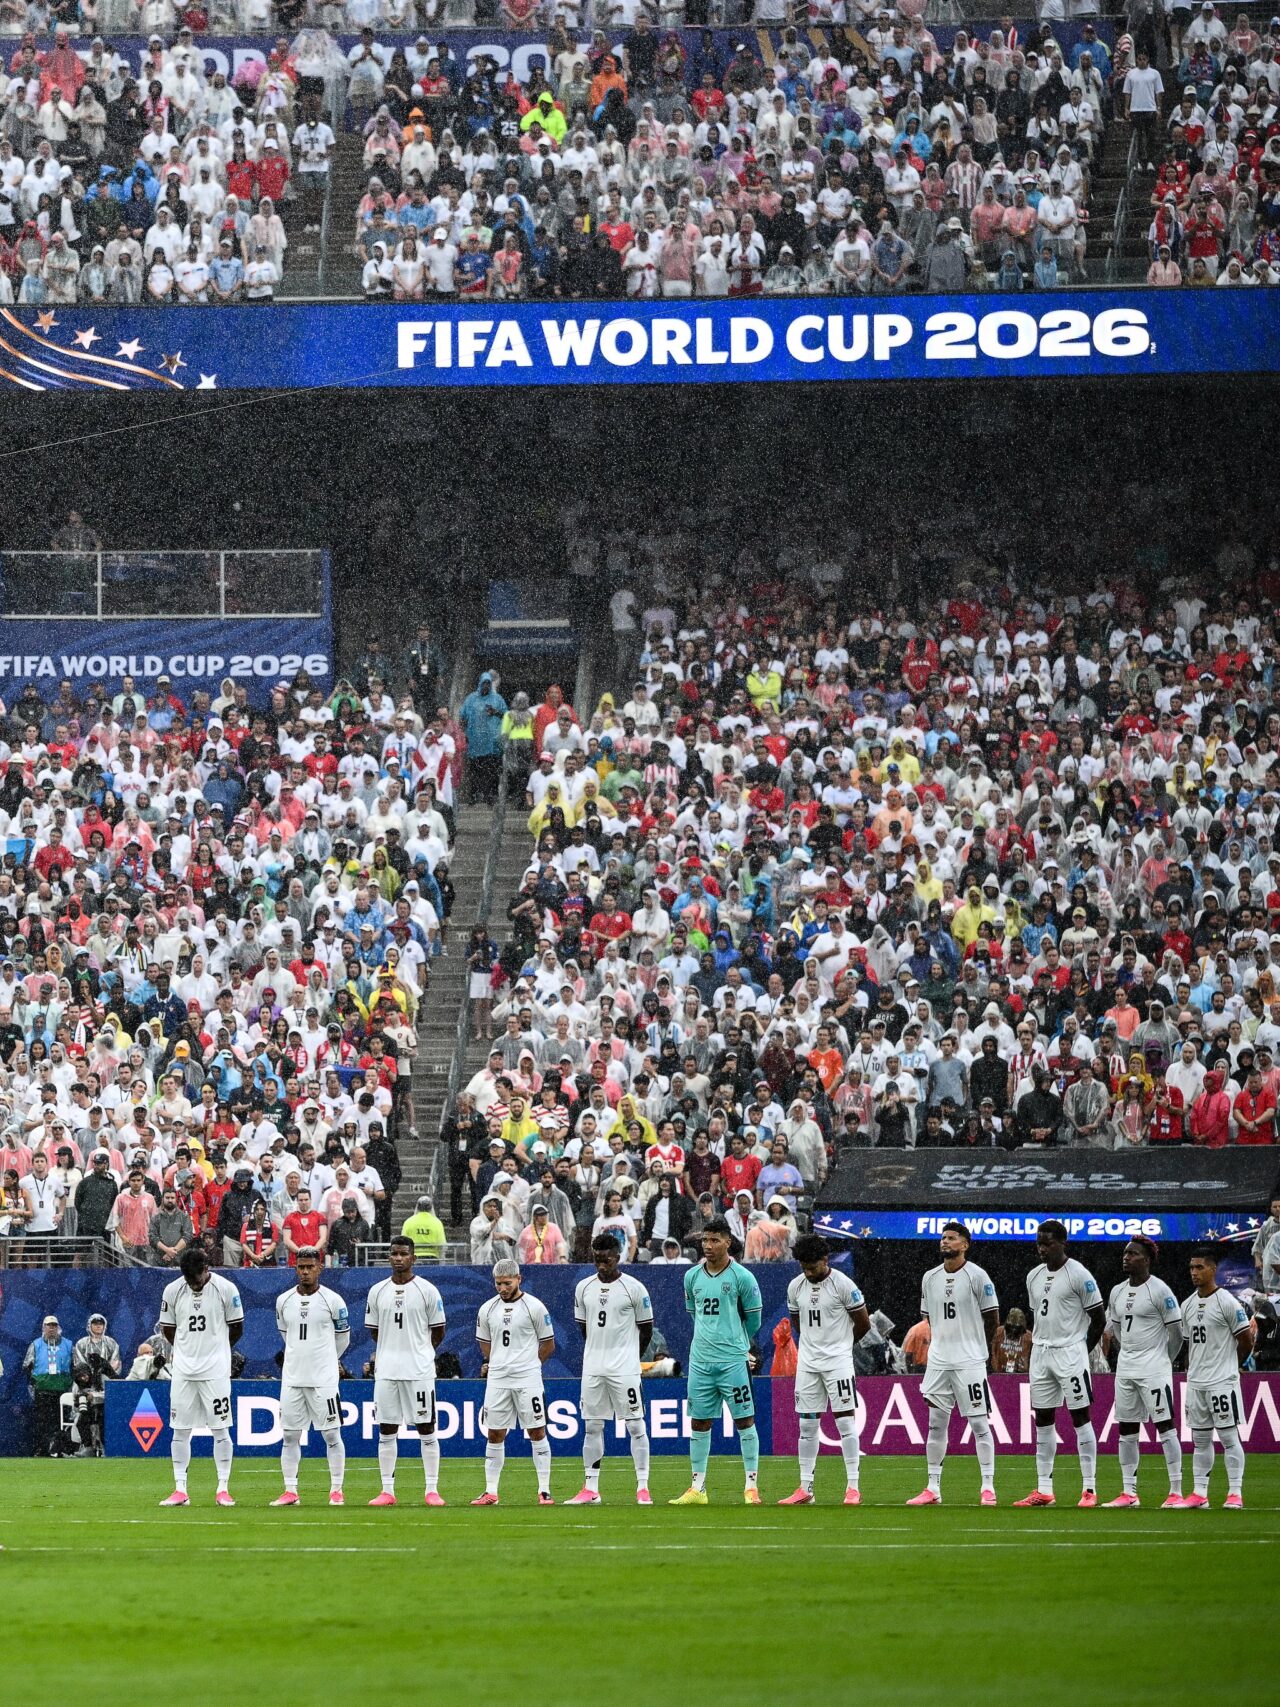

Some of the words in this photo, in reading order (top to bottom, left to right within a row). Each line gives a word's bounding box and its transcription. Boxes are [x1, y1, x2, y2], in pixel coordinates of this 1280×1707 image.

[397, 319, 533, 369] FIFA
[540, 316, 774, 367] WORLD
[786, 313, 913, 363] CUP
[925, 308, 1150, 360] 2026
[61, 655, 164, 677] WORLD
[169, 655, 225, 677] CUP
[229, 653, 329, 677] 2026
[936, 1173, 1125, 1182] WORLD
[940, 1165, 1048, 1173] FIFA
[930, 1181, 1035, 1191] CUP
[917, 1217, 959, 1235] FIF
[964, 1218, 1040, 1235] WORLD
[1087, 1218, 1161, 1236] 2026
[703, 1297, 720, 1316] 22
[943, 1301, 956, 1320] 16
[1040, 1298, 1049, 1317] 3
[188, 1315, 206, 1332] 23
[394, 1312, 403, 1329] 4
[598, 1310, 607, 1328] 9
[808, 1309, 821, 1327] 14
[1124, 1314, 1133, 1333] 7
[299, 1323, 308, 1340] 11
[502, 1329, 511, 1347] 6
[1192, 1325, 1207, 1344] 26
[732, 1385, 751, 1404] 22
[836, 1379, 851, 1397] 14
[967, 1382, 983, 1401] 16
[1071, 1377, 1082, 1394] 3
[416, 1391, 426, 1408] 4
[531, 1396, 542, 1414] 6
[627, 1387, 637, 1405] 9
[1151, 1388, 1162, 1407] 7
[1211, 1394, 1230, 1413] 26
[212, 1397, 229, 1416] 23
[326, 1397, 336, 1415] 11
